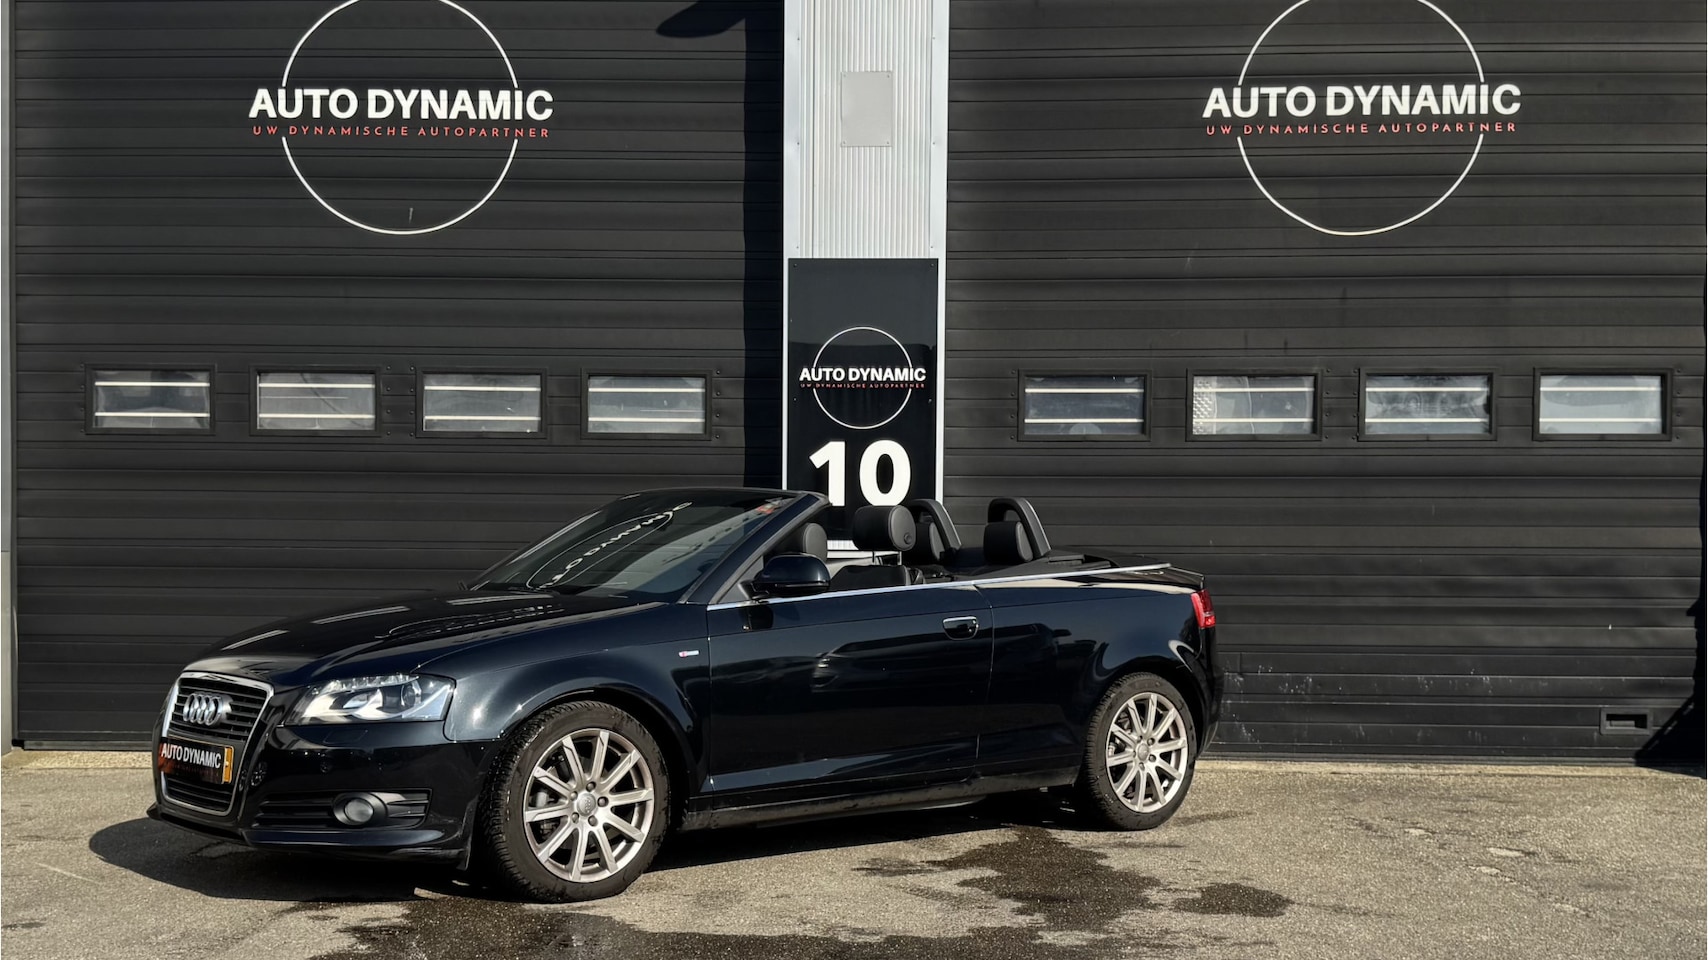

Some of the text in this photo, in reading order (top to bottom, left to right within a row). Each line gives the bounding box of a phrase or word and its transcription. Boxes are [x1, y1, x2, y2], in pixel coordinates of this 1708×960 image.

[249, 88, 554, 121] AUTO DYNAMIC
[1202, 84, 1522, 118] AUTO DYNAMIC
[252, 125, 549, 138] UW DYNAMISCHE AUTOPARTNER
[1206, 122, 1516, 136] UW DYNAMISCHE AUTOPARTNER
[799, 367, 927, 382] AUTO DYNAMIC
[809, 439, 911, 507] 10
[161, 742, 222, 769] AUTO DYNAMIC
